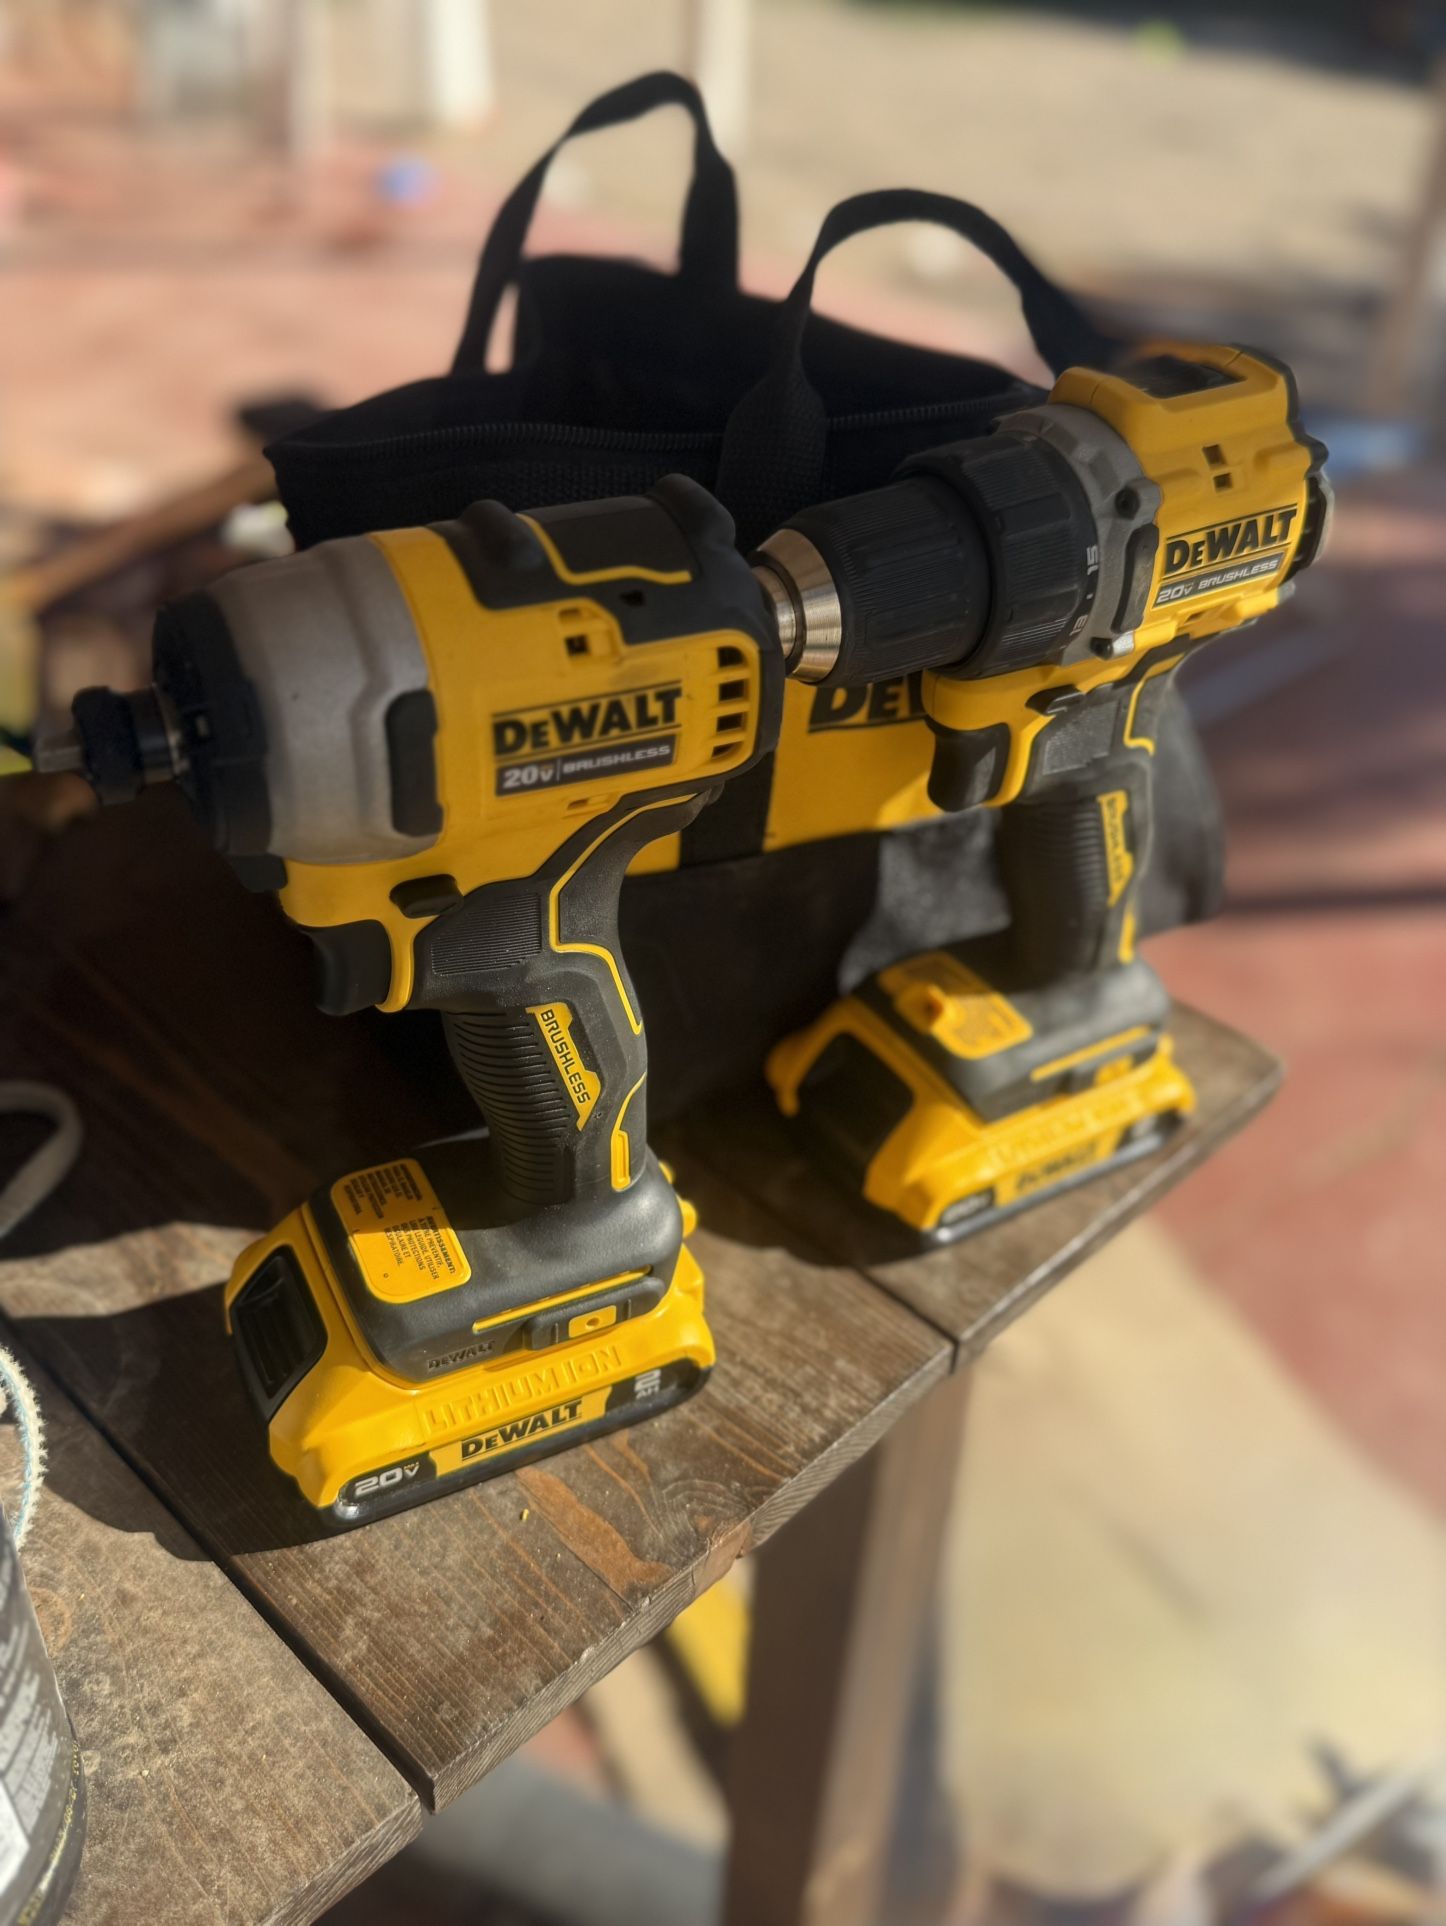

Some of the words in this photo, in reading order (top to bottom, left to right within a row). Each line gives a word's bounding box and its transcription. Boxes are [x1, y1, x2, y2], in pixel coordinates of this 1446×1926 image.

[1198, 559, 1278, 590] BRUSHLESS
[563, 745, 671, 774] BRUSHLESS
[541, 1009, 591, 1104] BRUSHLESS
[424, 1369, 560, 1434] LITHIUM
[563, 1344, 622, 1395] ION
